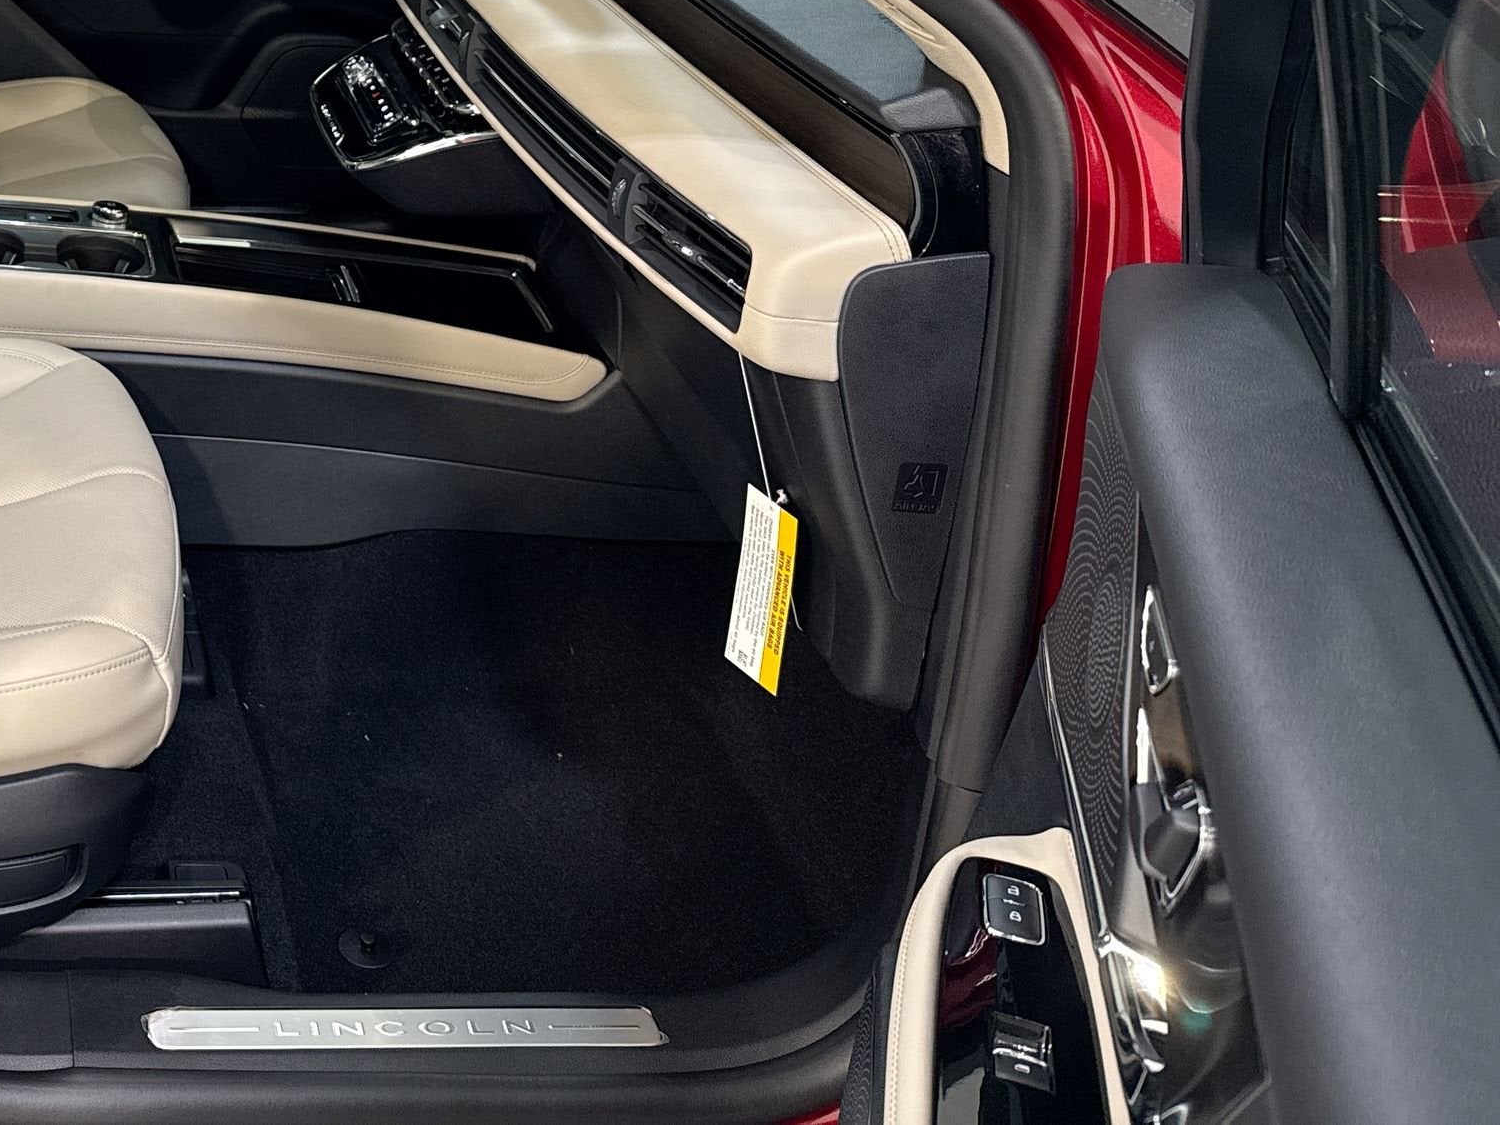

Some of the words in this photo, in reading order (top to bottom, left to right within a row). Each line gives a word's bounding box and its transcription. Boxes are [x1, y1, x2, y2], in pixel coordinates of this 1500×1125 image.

[777, 548, 785, 571] WITH
[784, 552, 792, 574] THIS
[771, 569, 782, 613] ADVANCED
[780, 571, 789, 607] VEHICLE
[778, 605, 785, 616] IS
[766, 626, 774, 650] BAGS
[773, 615, 783, 657] EQUIPPED
[273, 1020, 535, 1036] LINCOLN
